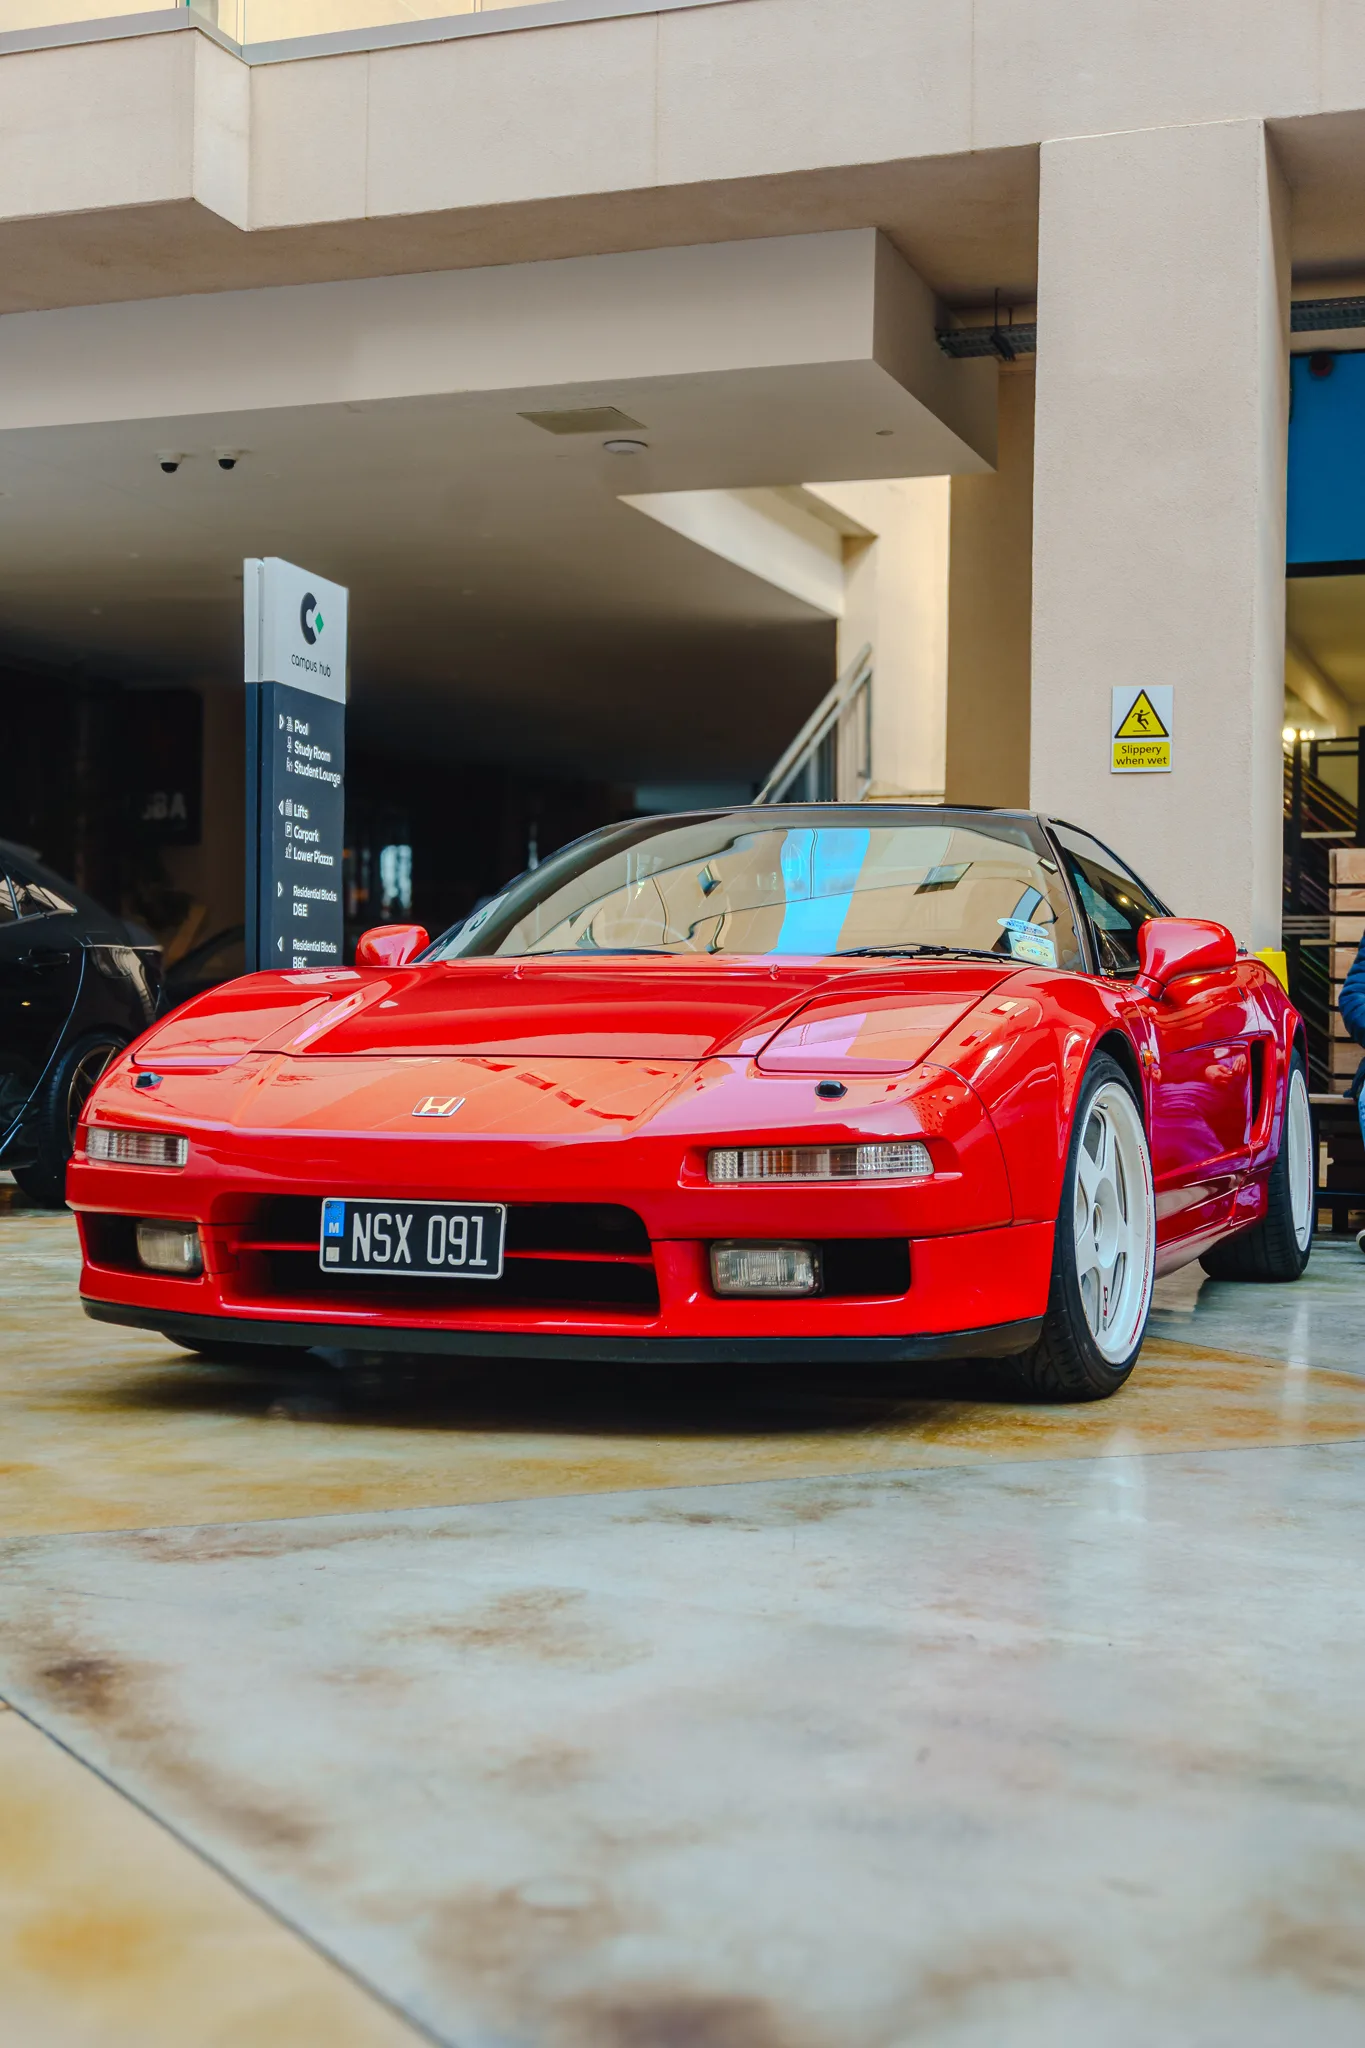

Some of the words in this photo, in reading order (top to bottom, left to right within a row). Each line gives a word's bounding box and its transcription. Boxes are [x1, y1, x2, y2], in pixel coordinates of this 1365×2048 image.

[291, 653, 318, 673] campus
[319, 660, 331, 678] hub
[294, 719, 309, 736] Pool
[294, 741, 313, 761] Study
[314, 745, 331, 763] Room
[1122, 745, 1162, 756] Slippery
[1116, 756, 1144, 765] when
[294, 761, 319, 779] Student
[319, 766, 341, 788] Lounge
[294, 803, 309, 820] Lifts
[293, 826, 320, 844] Carpark
[293, 846, 313, 864] Lower
[314, 850, 334, 866] Piazza
[293, 885, 321, 900] Residential
[321, 889, 338, 902] Blocks
[292, 939, 320, 953] Residential
[320, 942, 337, 954] Blocks
[328, 1222, 339, 1234] M
[352, 1212, 414, 1264] NSX
[426, 1214, 488, 1266] 091
